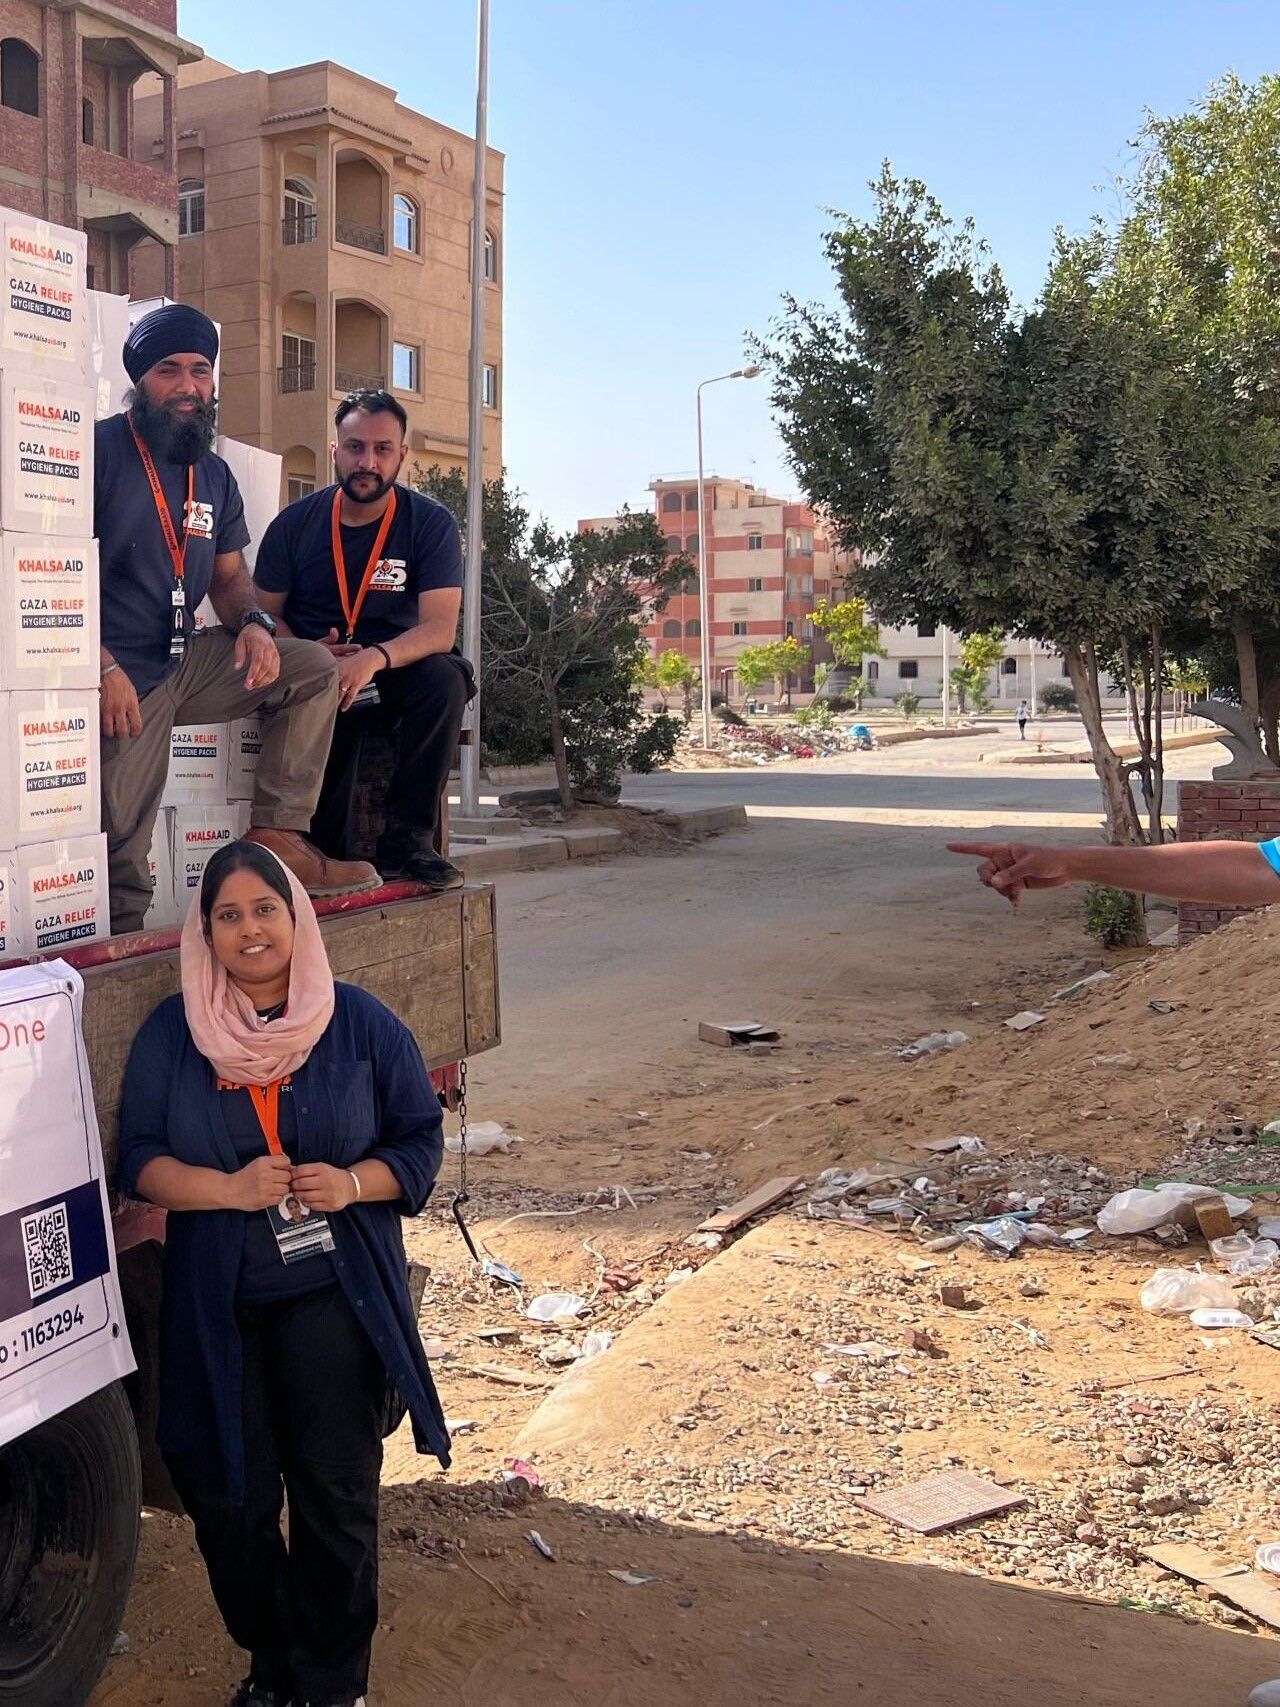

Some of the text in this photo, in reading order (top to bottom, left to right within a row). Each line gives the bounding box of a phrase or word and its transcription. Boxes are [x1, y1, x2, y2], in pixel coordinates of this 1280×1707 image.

[9, 277, 73, 304] GAZA RELIEF
[21, 460, 78, 477] HYGIENE PACKS
[171, 733, 218, 744] GAZA RELIEF
[241, 731, 259, 740] GAZA
[173, 748, 216, 756] HYGIENE PACKS
[24, 756, 87, 774] GAZA RELIEF
[38, 924, 95, 946] HYGIENE PACKS
[21, 1304, 84, 1352] 1163294
